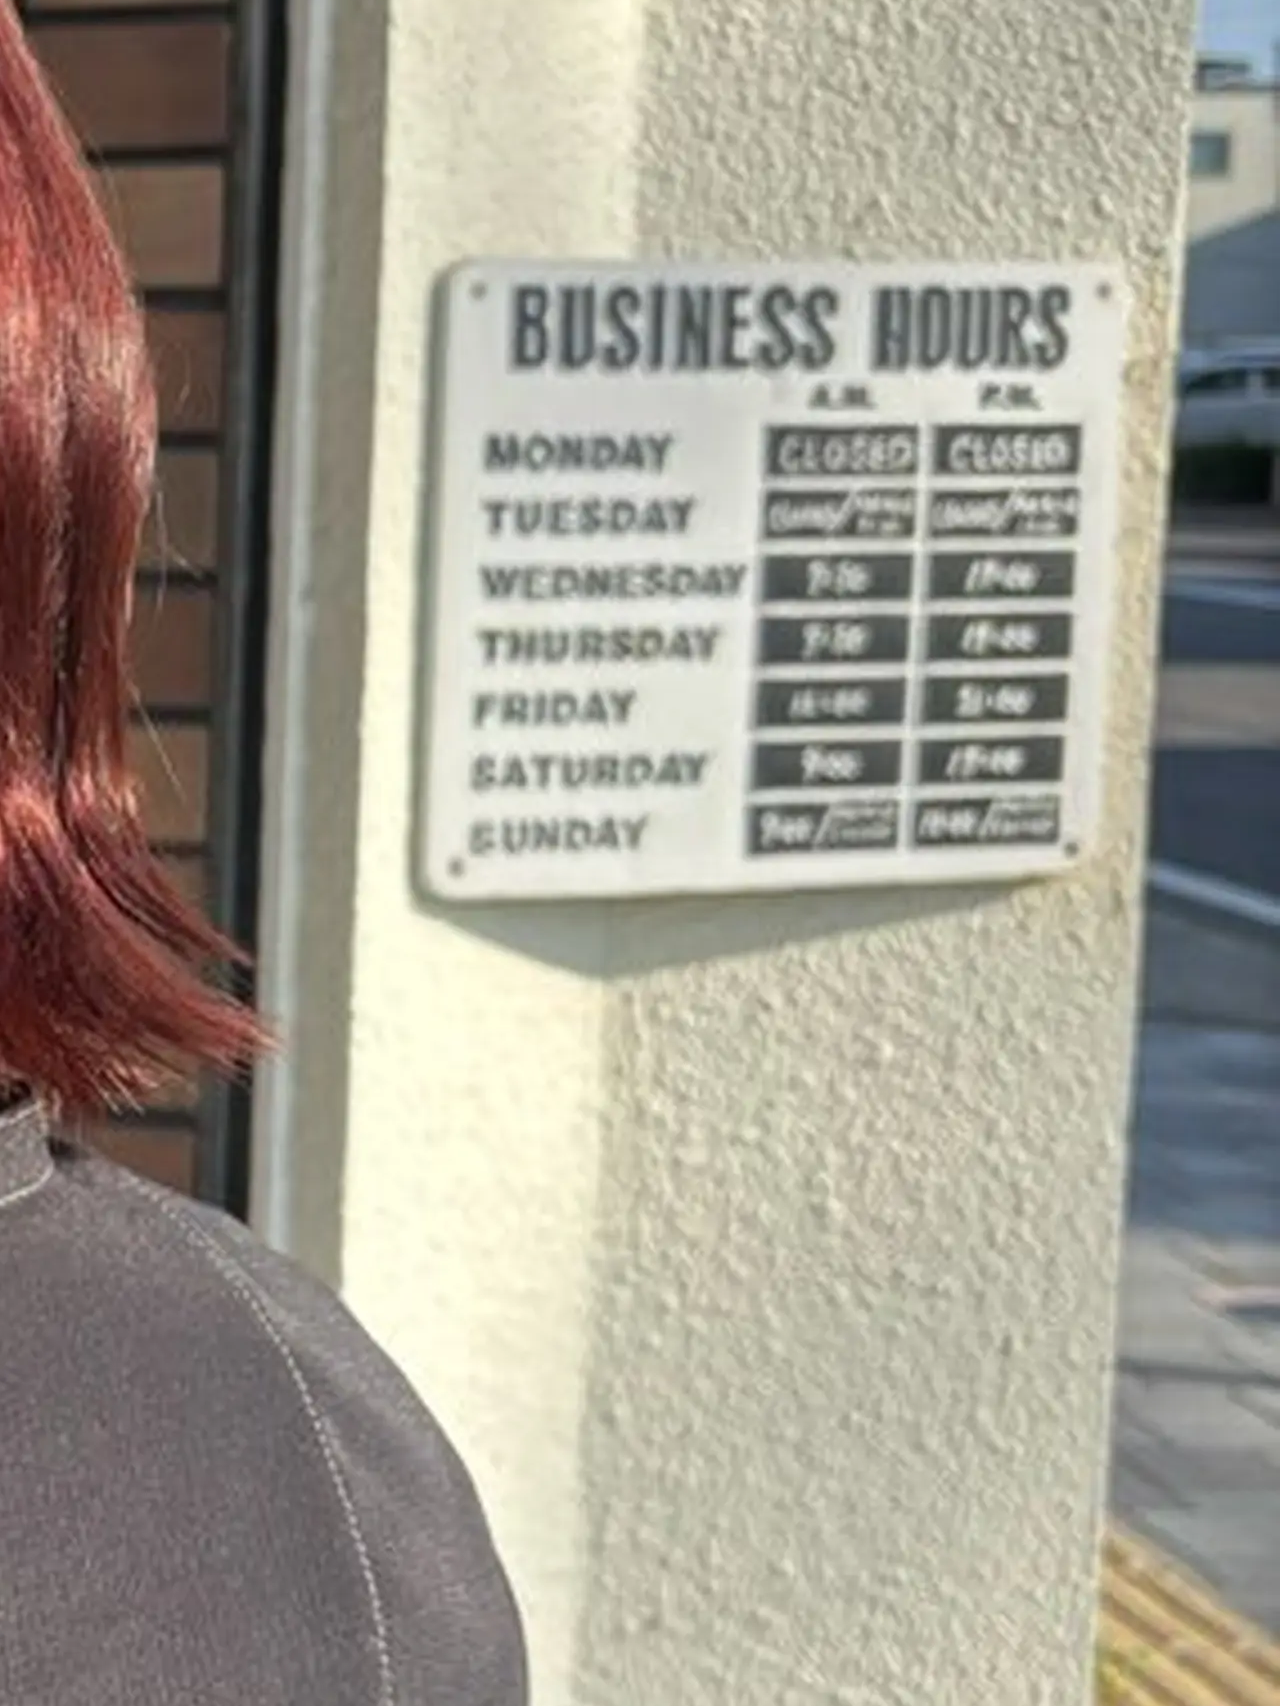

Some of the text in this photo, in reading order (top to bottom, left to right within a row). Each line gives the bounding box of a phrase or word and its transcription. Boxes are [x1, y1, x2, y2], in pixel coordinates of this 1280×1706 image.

[508, 283, 1073, 371] BUSINESS HOURS
[484, 432, 675, 473] MONDAY
[778, 433, 915, 473] CLOSED
[482, 495, 696, 536] TUESDAY
[480, 561, 747, 599] WEDNESDAY
[477, 623, 720, 665] THURSDAY
[473, 689, 638, 729] FRIDAY
[471, 749, 710, 792] SATURDAY
[469, 812, 648, 855] SUNDAY
